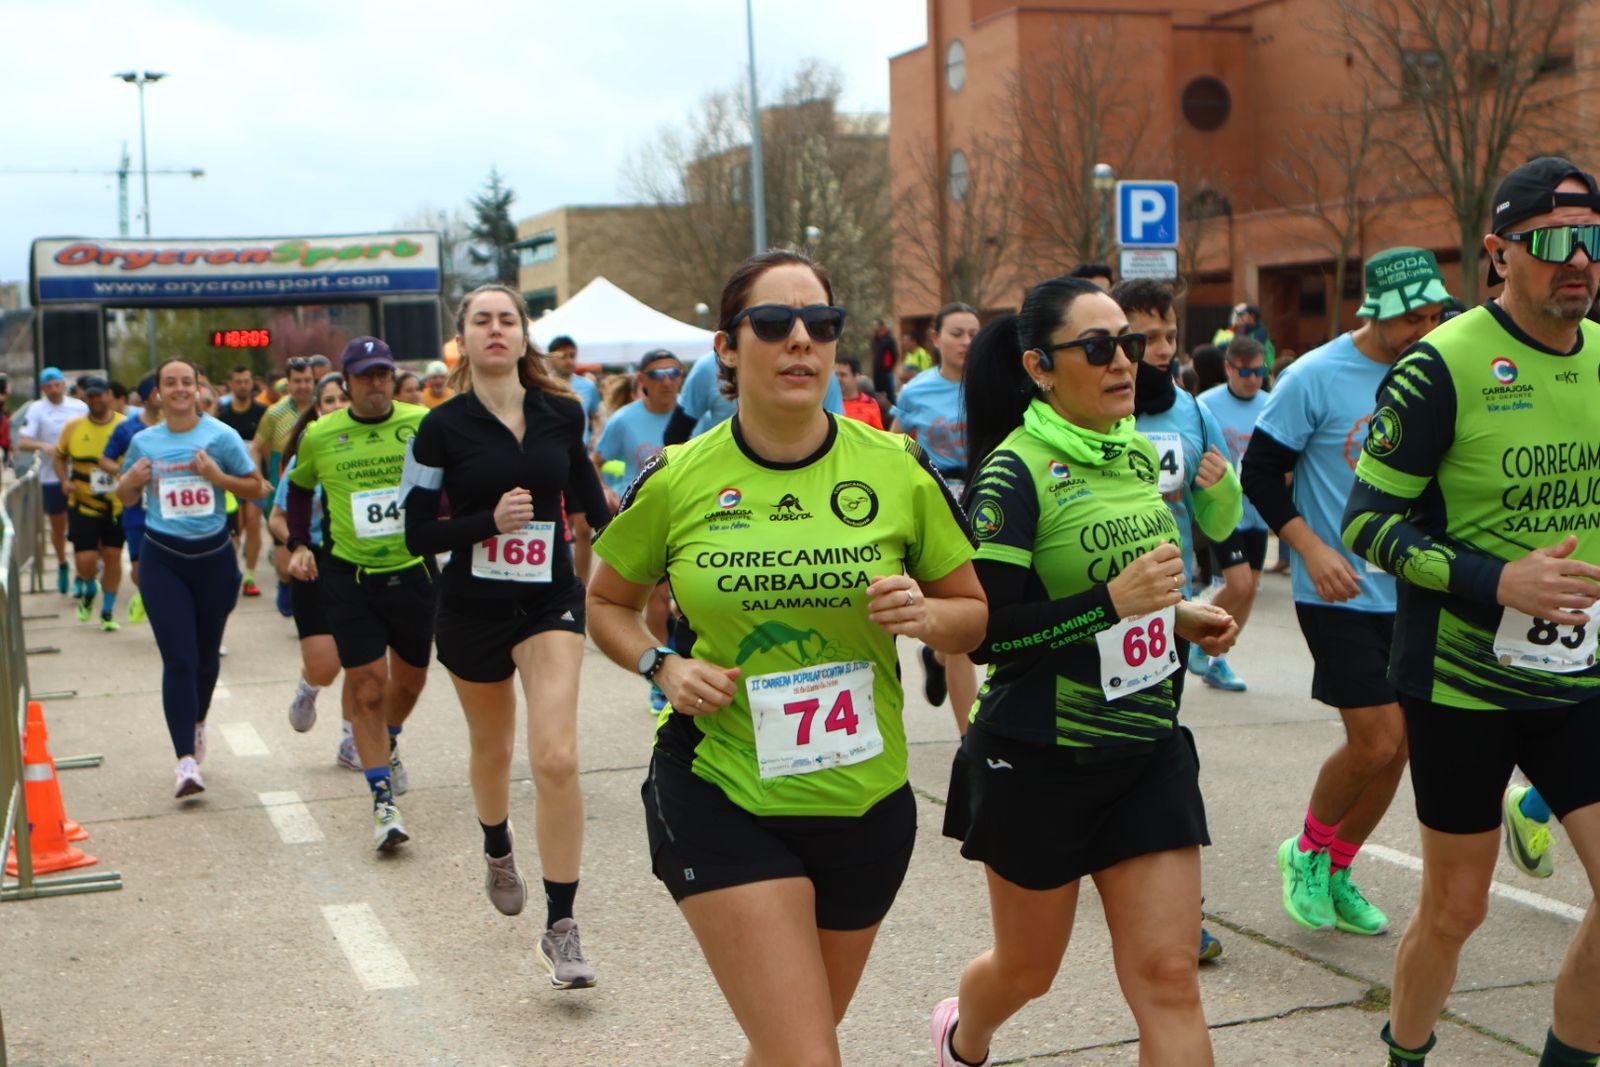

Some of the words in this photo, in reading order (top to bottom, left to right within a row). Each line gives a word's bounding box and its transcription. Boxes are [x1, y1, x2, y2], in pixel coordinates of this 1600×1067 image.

[1131, 189, 1166, 239] P
[93, 274, 391, 293] www.orycronsport.com
[1482, 384, 1534, 395] CARBAJOSA
[336, 454, 405, 472] CORRECAMIN
[347, 465, 402, 480] CARBAJOS
[1160, 449, 1179, 475] 4
[1502, 442, 1600, 478] CORRECAM
[166, 487, 210, 508] 186
[1502, 476, 1600, 511] CARBAJO
[367, 501, 400, 523] 84
[704, 509, 753, 520] CARBAJOSA
[1503, 512, 1600, 532] SALAMAN
[1080, 507, 1174, 553] CORRECAMIN
[482, 536, 546, 565] 168
[696, 544, 881, 568] CORRECAMINOS
[717, 571, 871, 592] CARBAJOSA
[741, 597, 852, 611] SALAMANCA
[991, 606, 1105, 652] CORRECAMINOS
[1050, 621, 1112, 649] CARBAJOSA
[1527, 610, 1586, 649] 83
[1123, 617, 1167, 667] 68
[784, 689, 858, 746] 74
